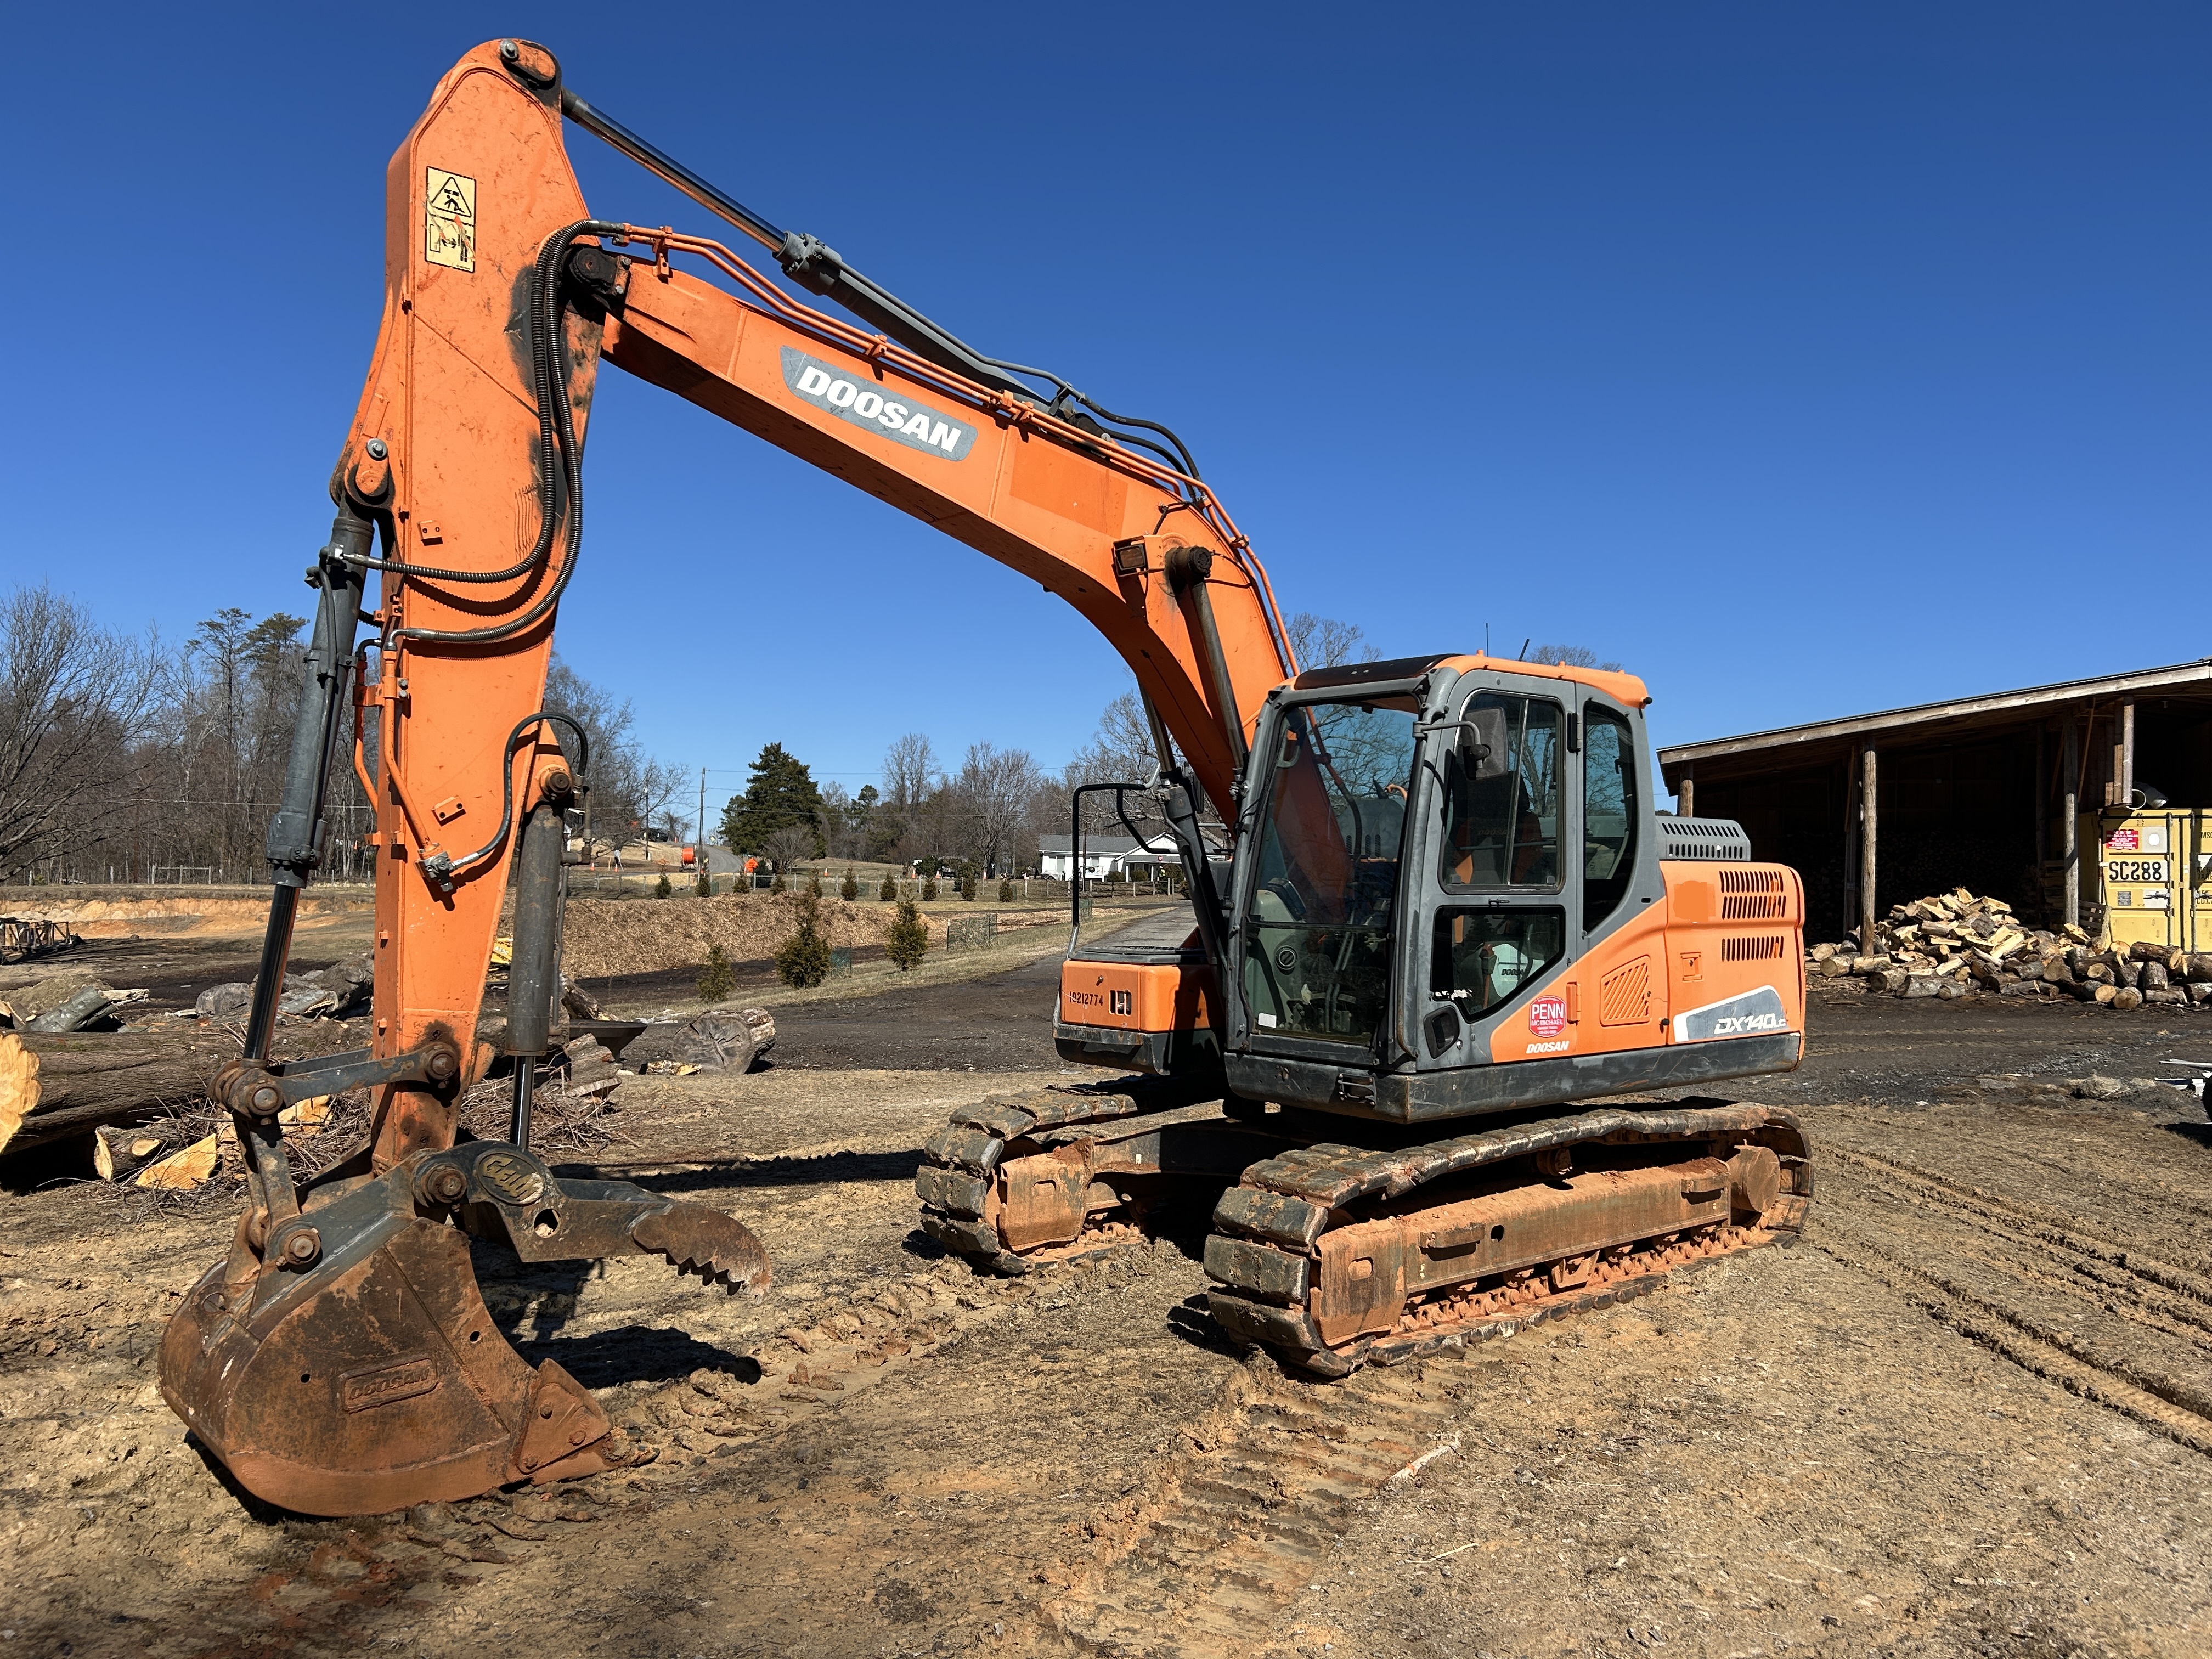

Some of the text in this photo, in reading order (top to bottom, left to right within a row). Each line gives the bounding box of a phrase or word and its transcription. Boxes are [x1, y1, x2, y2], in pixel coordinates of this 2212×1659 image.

[796, 365, 962, 452] DOOSAN
[2109, 861, 2162, 881] SC288
[1069, 991, 1103, 1006] 10212774
[1532, 1003, 1565, 1020] PENN
[1526, 1040, 1570, 1054] DOOSAN
[348, 1366, 430, 1400] DOOSAN
